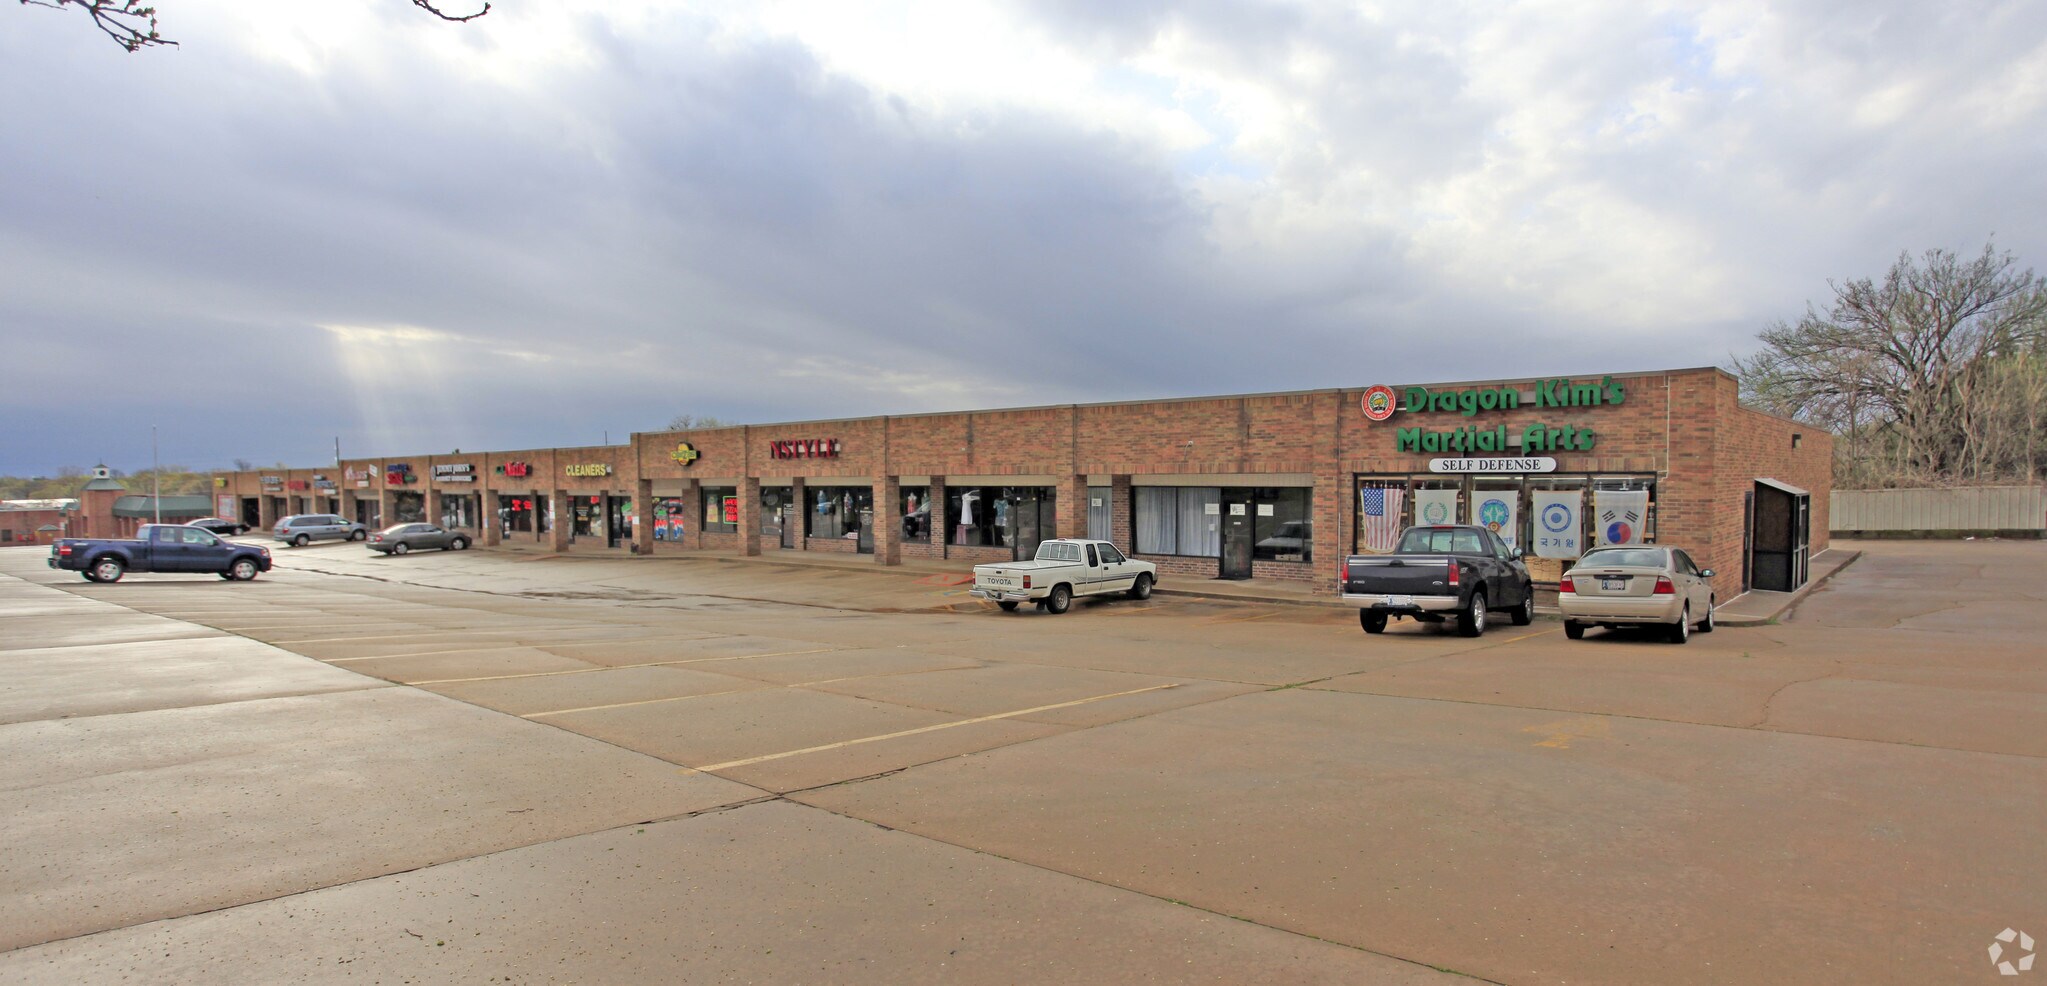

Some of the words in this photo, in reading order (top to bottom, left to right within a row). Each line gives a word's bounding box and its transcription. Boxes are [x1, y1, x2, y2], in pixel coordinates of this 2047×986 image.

[1405, 387, 1518, 416] Dragon
[1535, 376, 1625, 408] Kim's
[769, 437, 838, 459] NSTYLE
[1397, 424, 1507, 452] Martial
[1521, 423, 1595, 453] Arts
[565, 464, 606, 476] CLEANERS
[1442, 459, 1474, 471] SELF
[1478, 459, 1541, 471] DEFENSE
